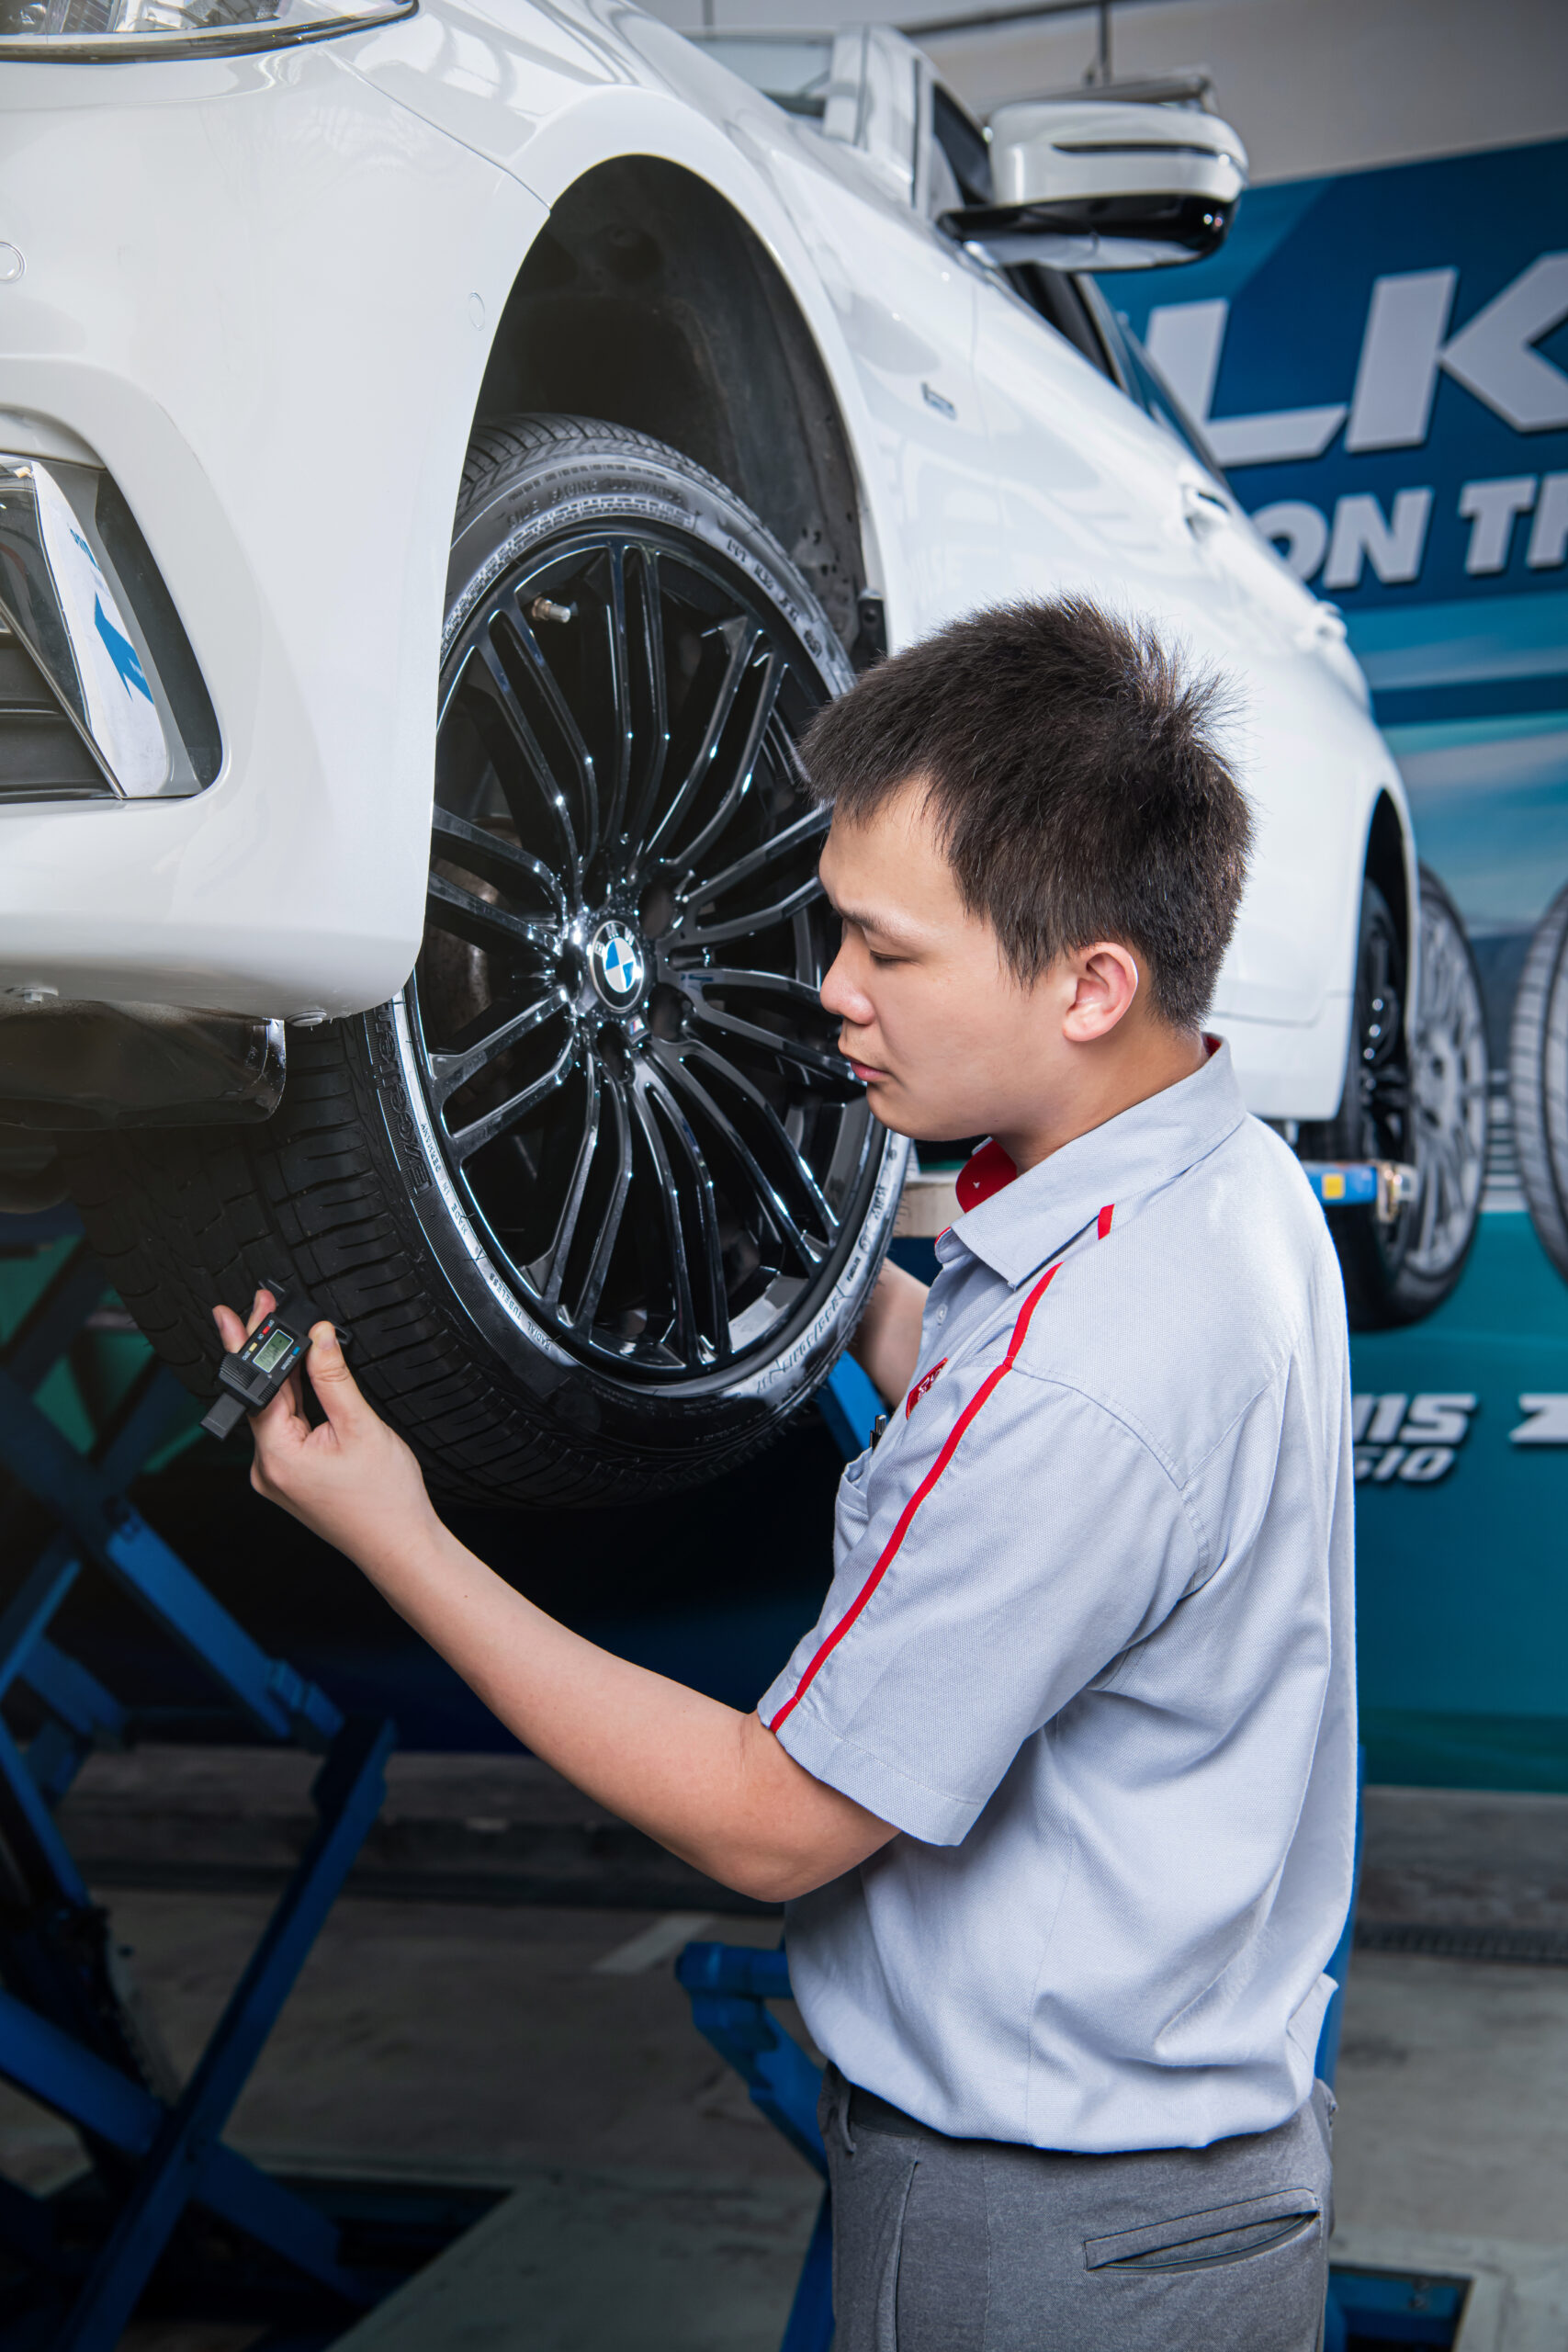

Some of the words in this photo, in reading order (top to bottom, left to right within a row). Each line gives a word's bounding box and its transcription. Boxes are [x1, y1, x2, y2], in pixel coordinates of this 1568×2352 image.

[451, 1203, 468, 1236] MADE
[489, 1272, 523, 1320] TUBELESS
[527, 1320, 551, 1351] RADIAL
